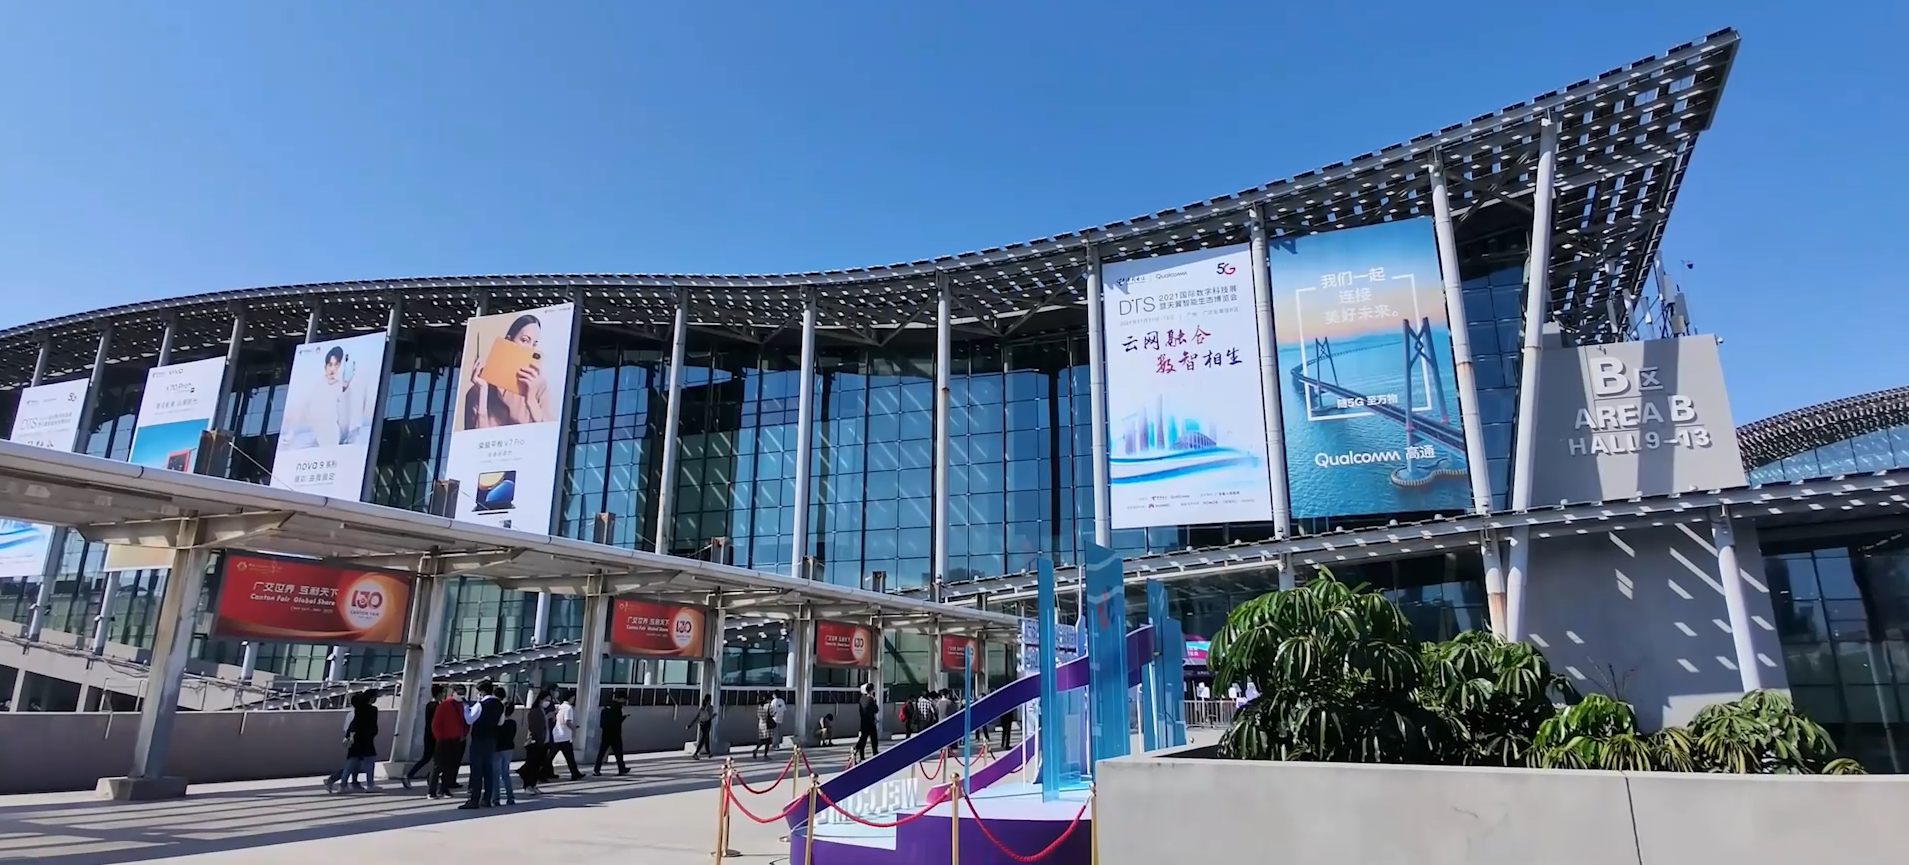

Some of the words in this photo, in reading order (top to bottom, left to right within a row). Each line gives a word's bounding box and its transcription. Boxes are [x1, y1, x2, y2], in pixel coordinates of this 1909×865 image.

[1216, 262, 1236, 275] 5G
[1320, 266, 1386, 289] 我们一起
[1158, 285, 1238, 302] 2021国际数字科技展
[1339, 287, 1373, 304] 连接
[1119, 296, 1156, 316] DTS
[1324, 304, 1399, 325] 美好未来。
[1121, 324, 1212, 353] 云网融合
[1156, 347, 1243, 374] 数智相生
[1574, 402, 1664, 431] AREA
[1668, 394, 1697, 423] B
[1568, 432, 1642, 456] HALL
[1644, 427, 1712, 450] 9-13
[296, 461, 318, 471] nova
[1314, 449, 1401, 468] Qualcomm
[1405, 444, 1436, 461] 高通
[250, 593, 275, 602] Canton
[293, 596, 317, 605] Global
[317, 598, 335, 606] Share
[253, 581, 295, 593] 广交世界
[299, 585, 339, 598] 互利天下
[351, 589, 383, 609] 130
